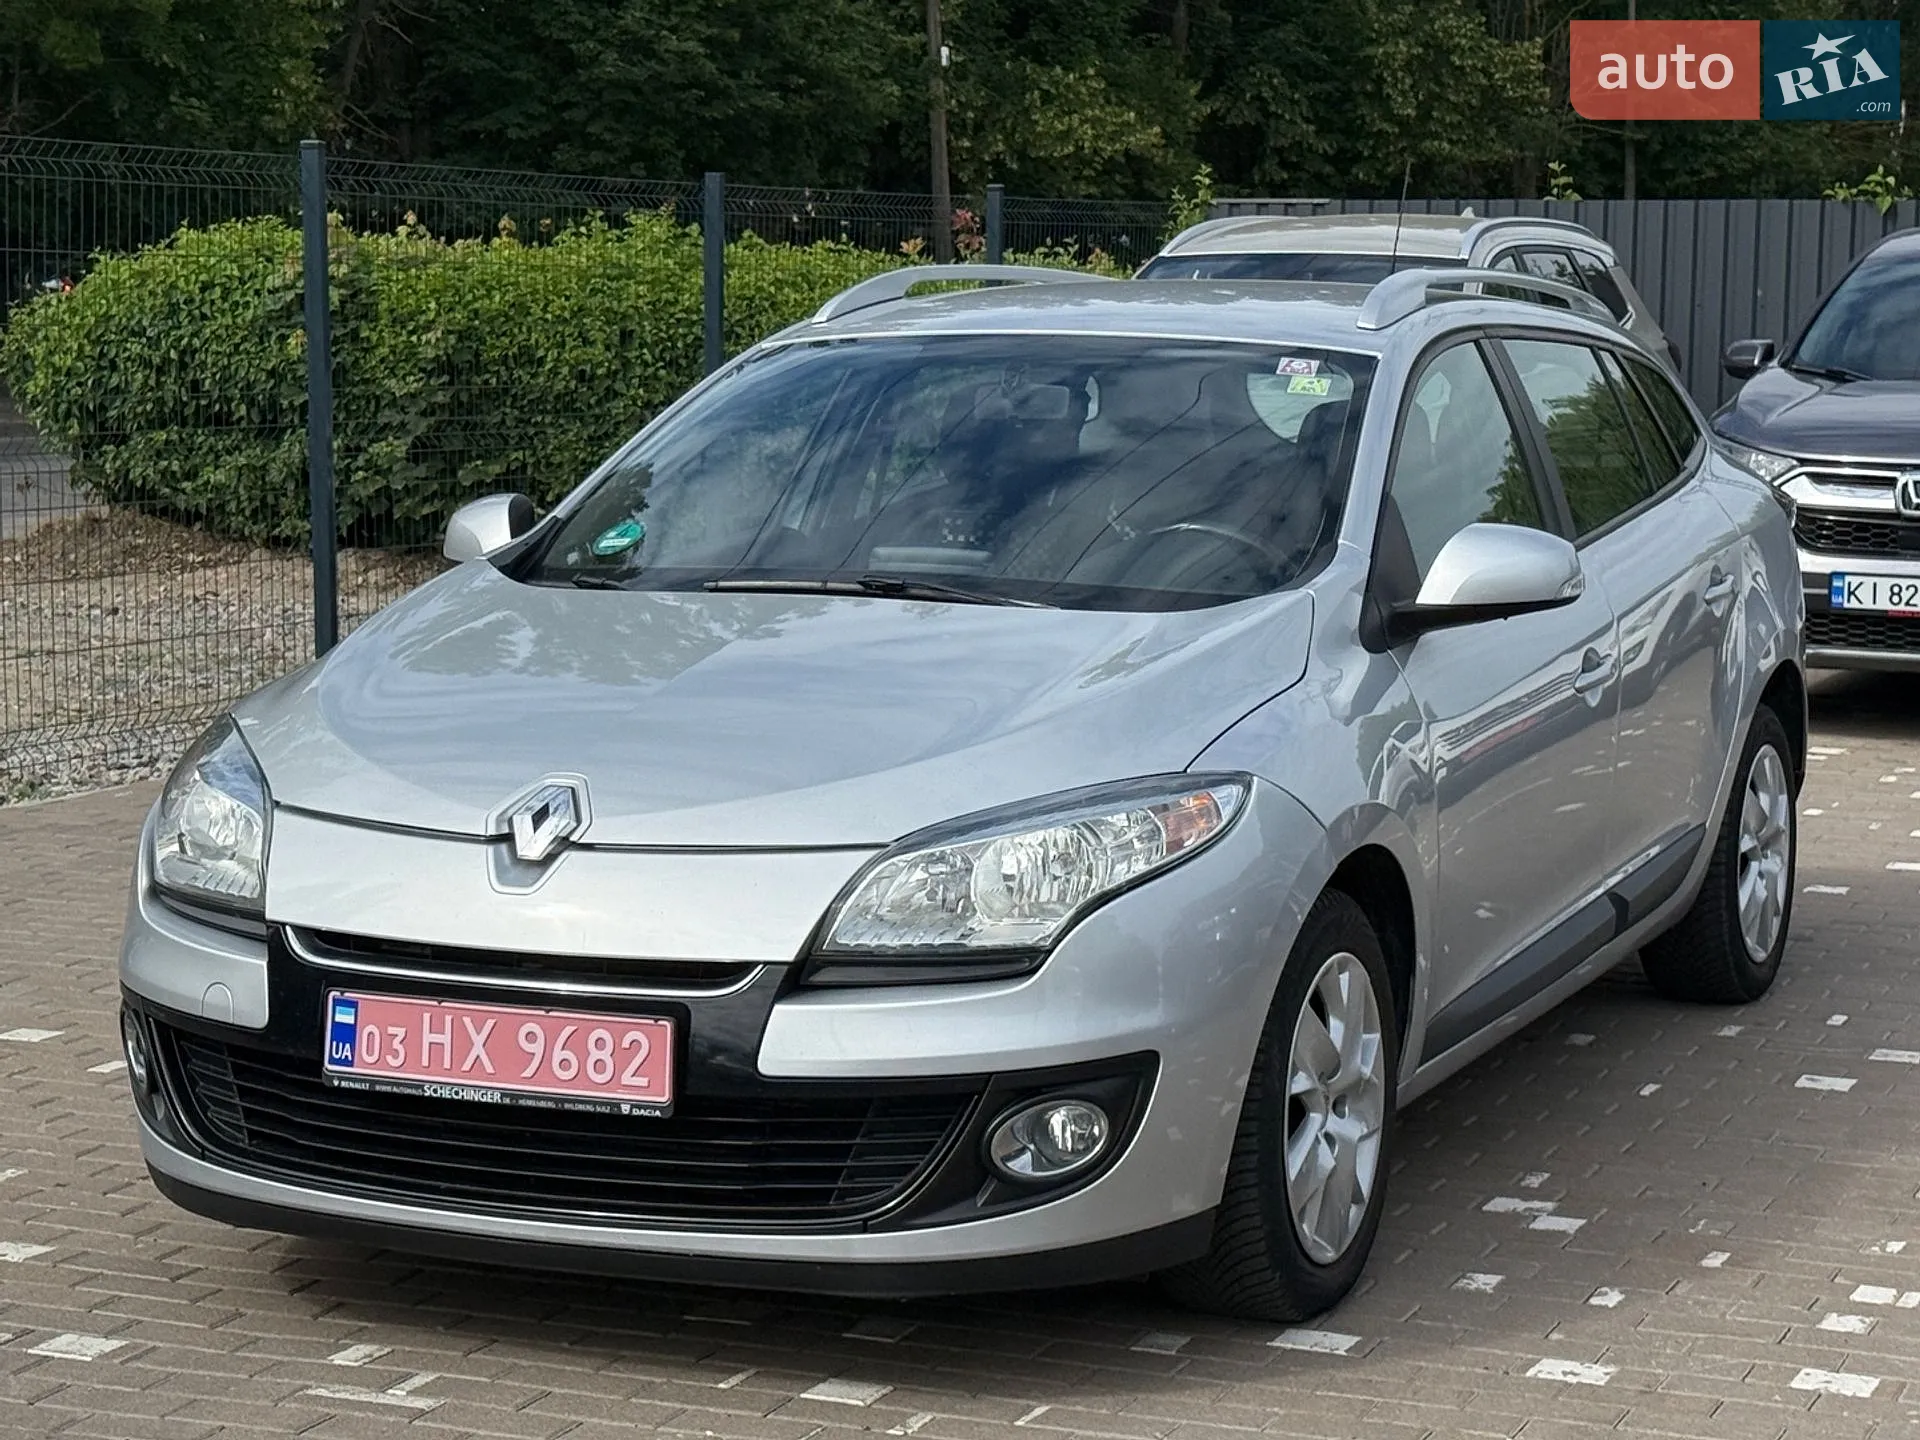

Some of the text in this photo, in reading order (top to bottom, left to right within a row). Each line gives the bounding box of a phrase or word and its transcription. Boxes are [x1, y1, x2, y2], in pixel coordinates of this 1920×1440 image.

[332, 1041, 352, 1061] UA
[361, 1012, 651, 1088] 03 HX 9682
[632, 1107, 661, 1117] DACIA
